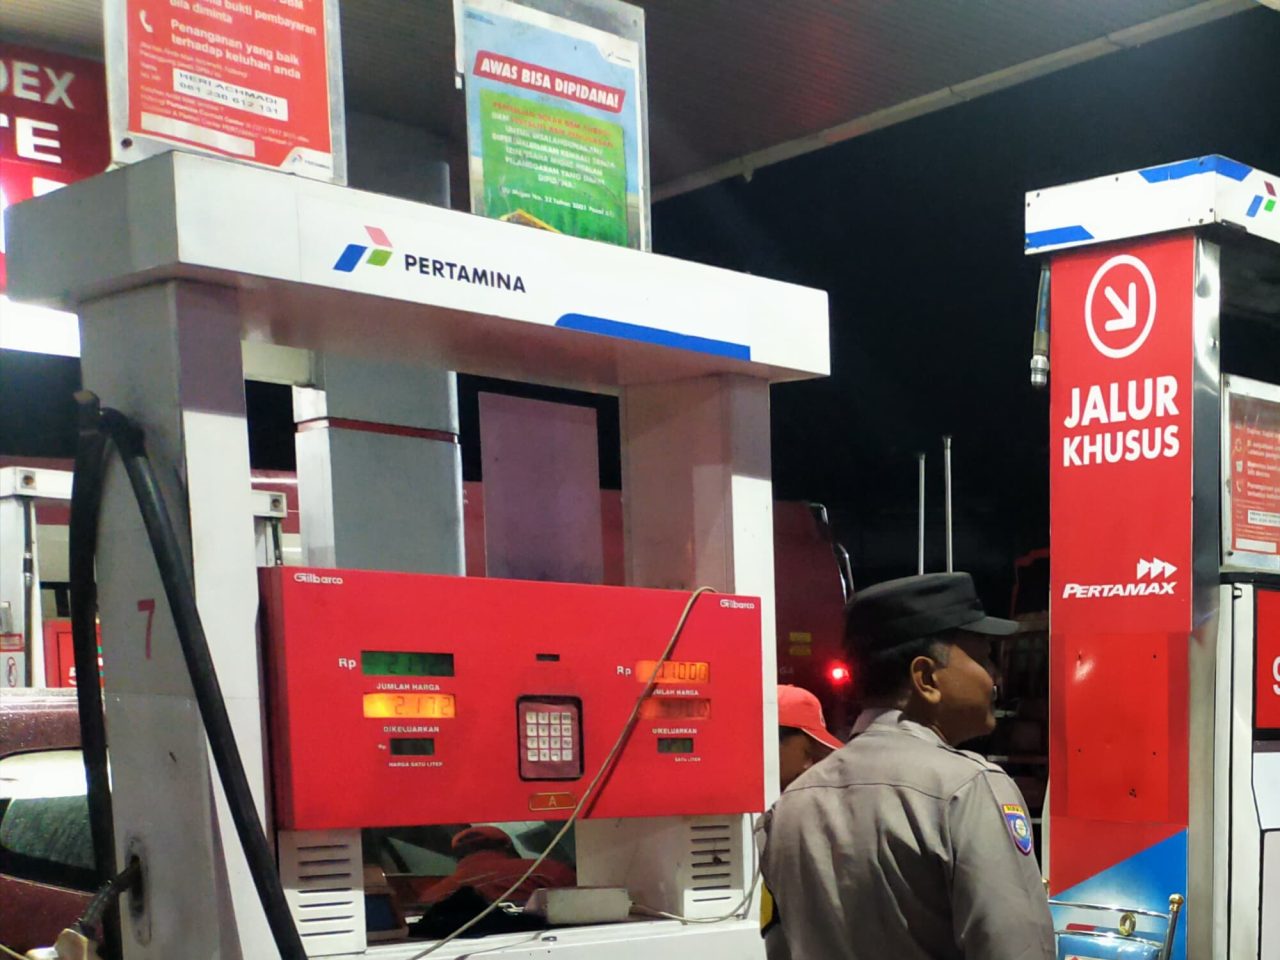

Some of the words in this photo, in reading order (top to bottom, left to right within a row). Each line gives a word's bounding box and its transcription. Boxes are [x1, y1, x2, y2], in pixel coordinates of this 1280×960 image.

[192, 2, 233, 24] diminta
[255, 10, 317, 36] pembayaran
[171, 19, 242, 49] Penanganan
[246, 43, 273, 60] yang
[277, 50, 299, 65] baik
[171, 34, 223, 58] terhadap
[225, 47, 271, 72] keluhan
[274, 65, 301, 79] anda
[0, 60, 75, 110] EX
[481, 58, 518, 80] AWAS
[521, 68, 551, 89] BISA
[555, 78, 619, 108] DIPIDANA!
[404, 253, 527, 293] PERTAMINA
[1064, 375, 1179, 429] JALUR
[1062, 424, 1180, 467] KHUSUS
[294, 572, 344, 585] Gilbarco
[1063, 580, 1177, 599] PERTAMAX
[138, 599, 155, 660] 7
[338, 658, 357, 670] Rp
[616, 666, 631, 675] Rp
[549, 795, 557, 807] A
